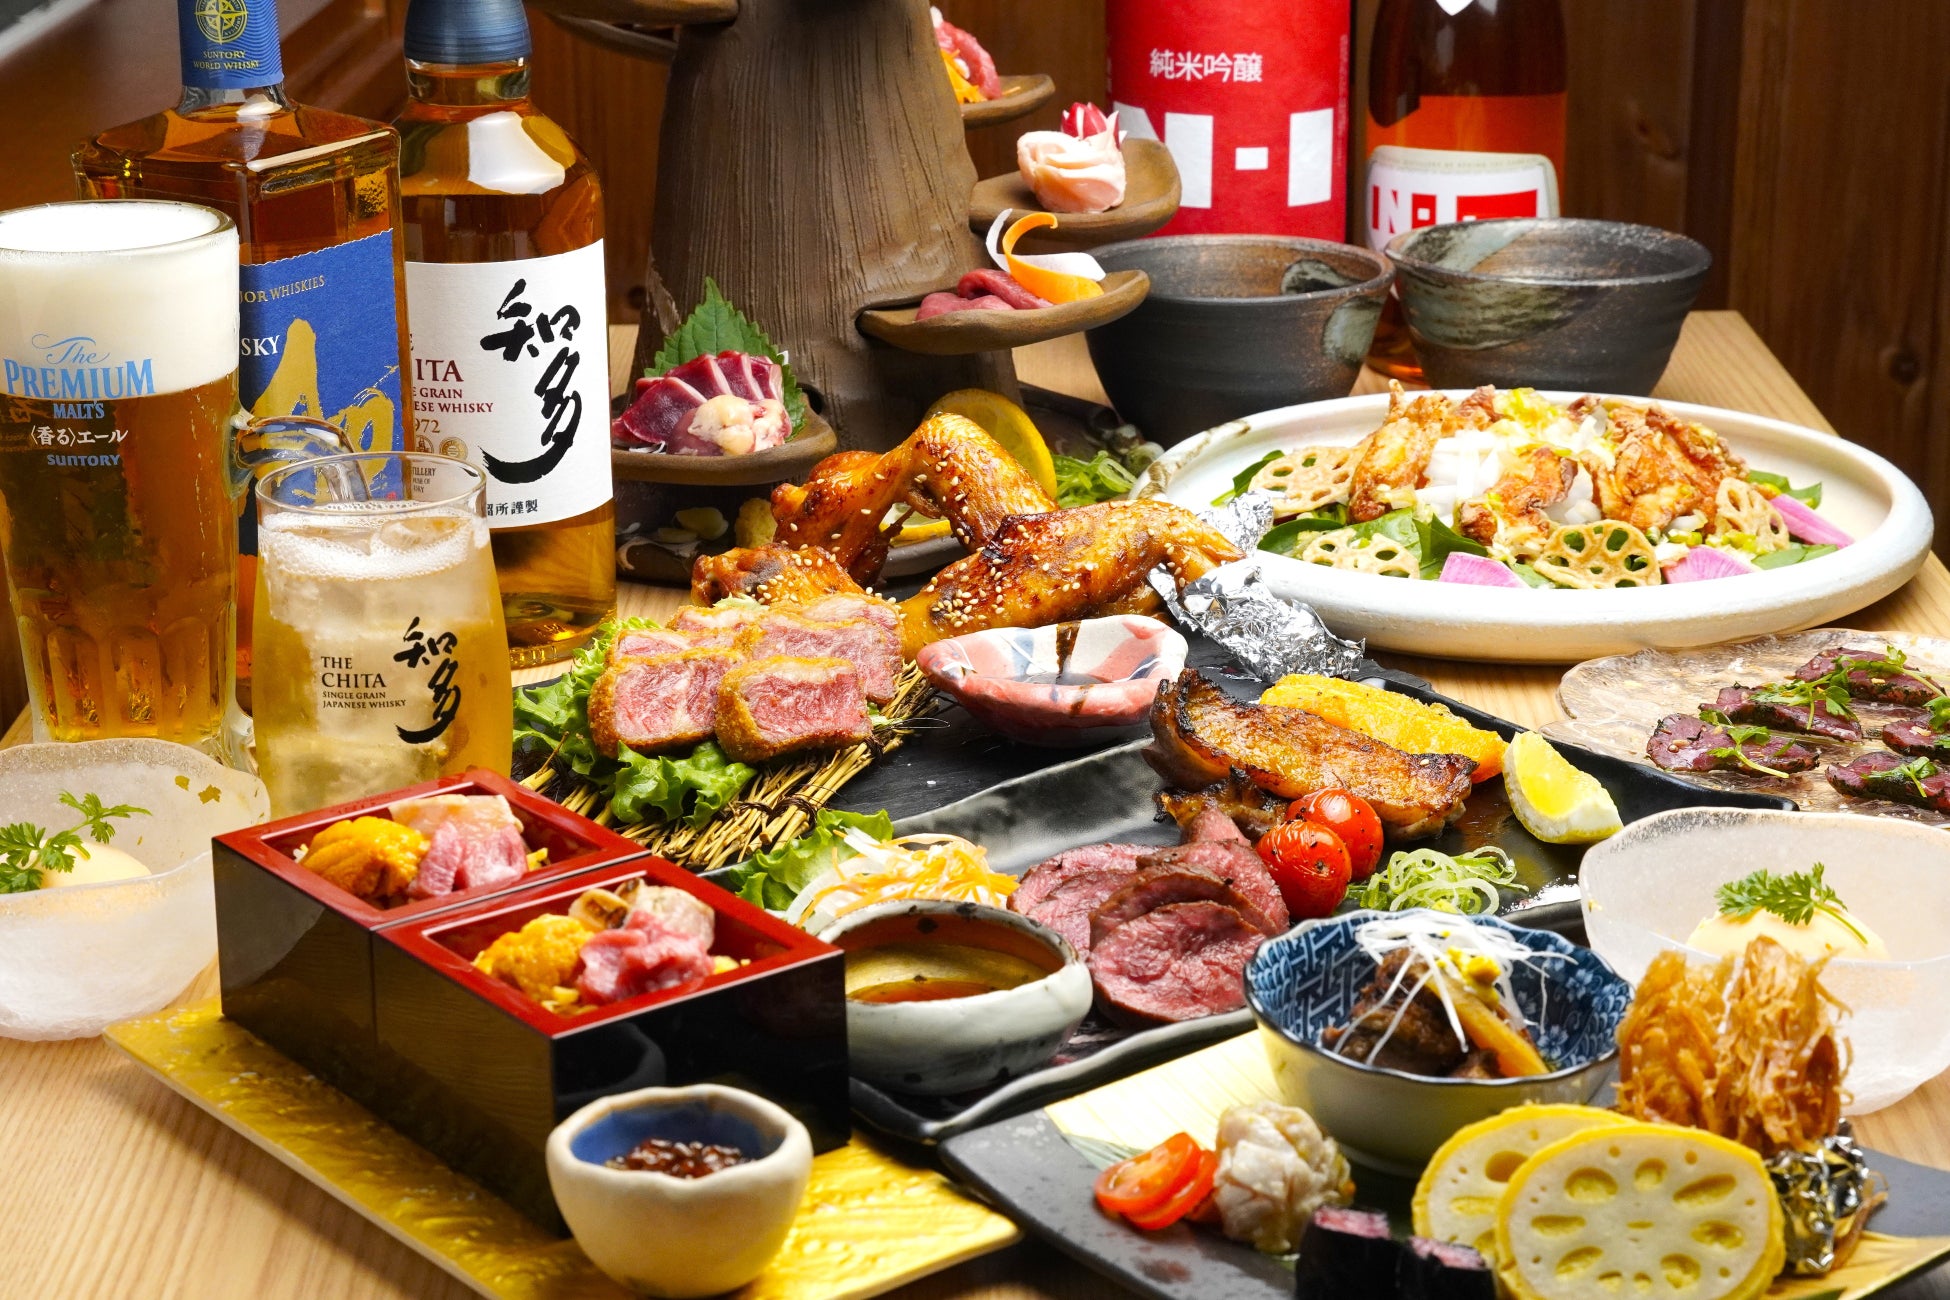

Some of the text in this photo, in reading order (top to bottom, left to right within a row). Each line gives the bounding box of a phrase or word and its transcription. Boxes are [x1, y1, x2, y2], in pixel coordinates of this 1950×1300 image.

[203, 50, 246, 59] SUNTORY
[193, 61, 220, 70] WORLD
[1149, 48, 1264, 83] 純米吟醸
[269, 275, 326, 300] WHISKIES
[31, 333, 111, 365] The
[3, 358, 157, 400] PREMIUM
[478, 278, 583, 484] 知多
[420, 387, 463, 399] GRAIN
[53, 400, 105, 420] MALT'S
[437, 402, 494, 414] WHISKY
[320, 656, 353, 670] THE
[321, 672, 387, 689] CHITA
[393, 616, 462, 745] 知多
[322, 690, 386, 700] SINGLE GRAIN
[322, 699, 407, 710] JAPANESE WHISKY
